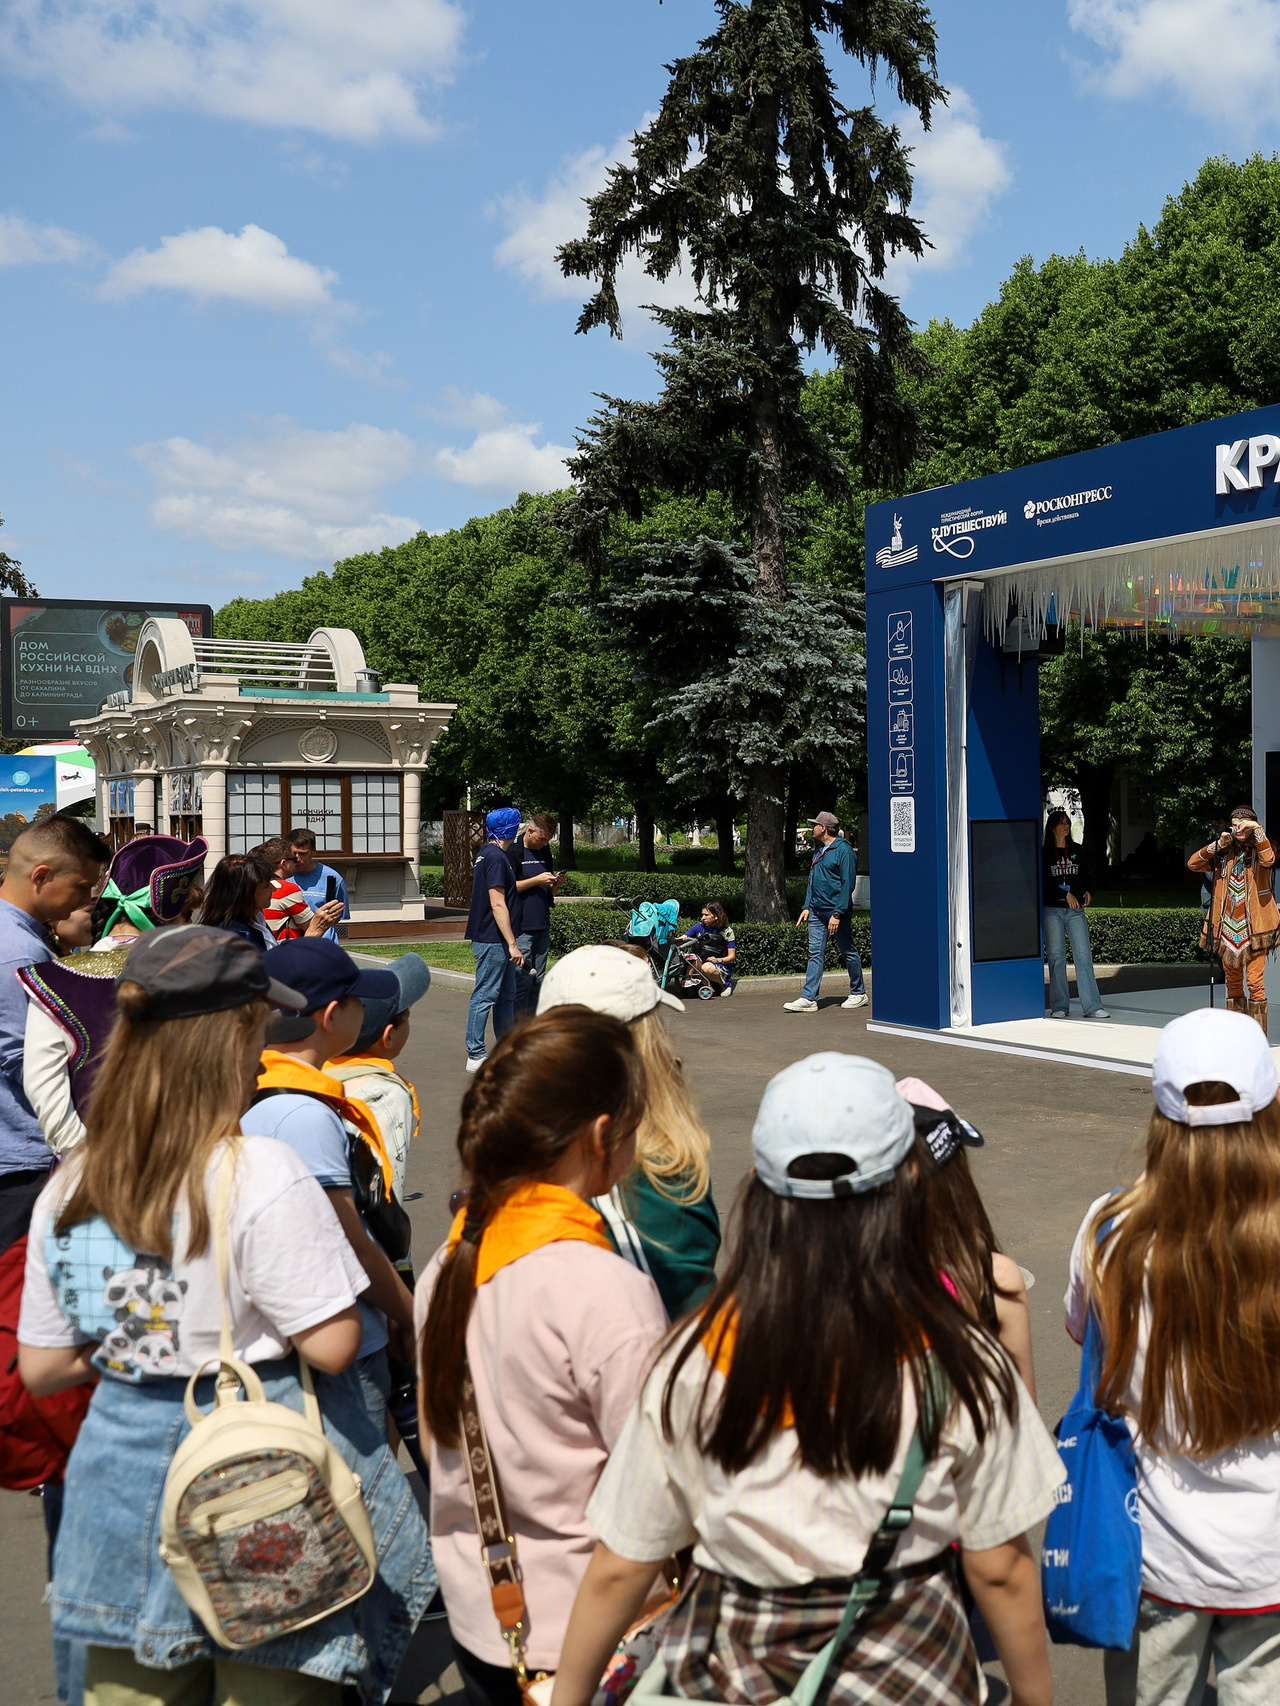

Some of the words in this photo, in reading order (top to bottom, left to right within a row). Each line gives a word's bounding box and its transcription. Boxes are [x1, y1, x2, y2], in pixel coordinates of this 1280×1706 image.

[1035, 485, 1113, 515] РОСКОНГРЕСС
[939, 510, 1008, 537] ПУТЕШЕСТВУЙ!
[19, 641, 49, 651] ДОМ
[20, 652, 106, 663] РОССИЙСКОЙ
[20, 664, 62, 673] КУХНИ
[66, 664, 82, 673] НА
[85, 665, 118, 675] ВДНХ
[16, 715, 39, 728] 0+
